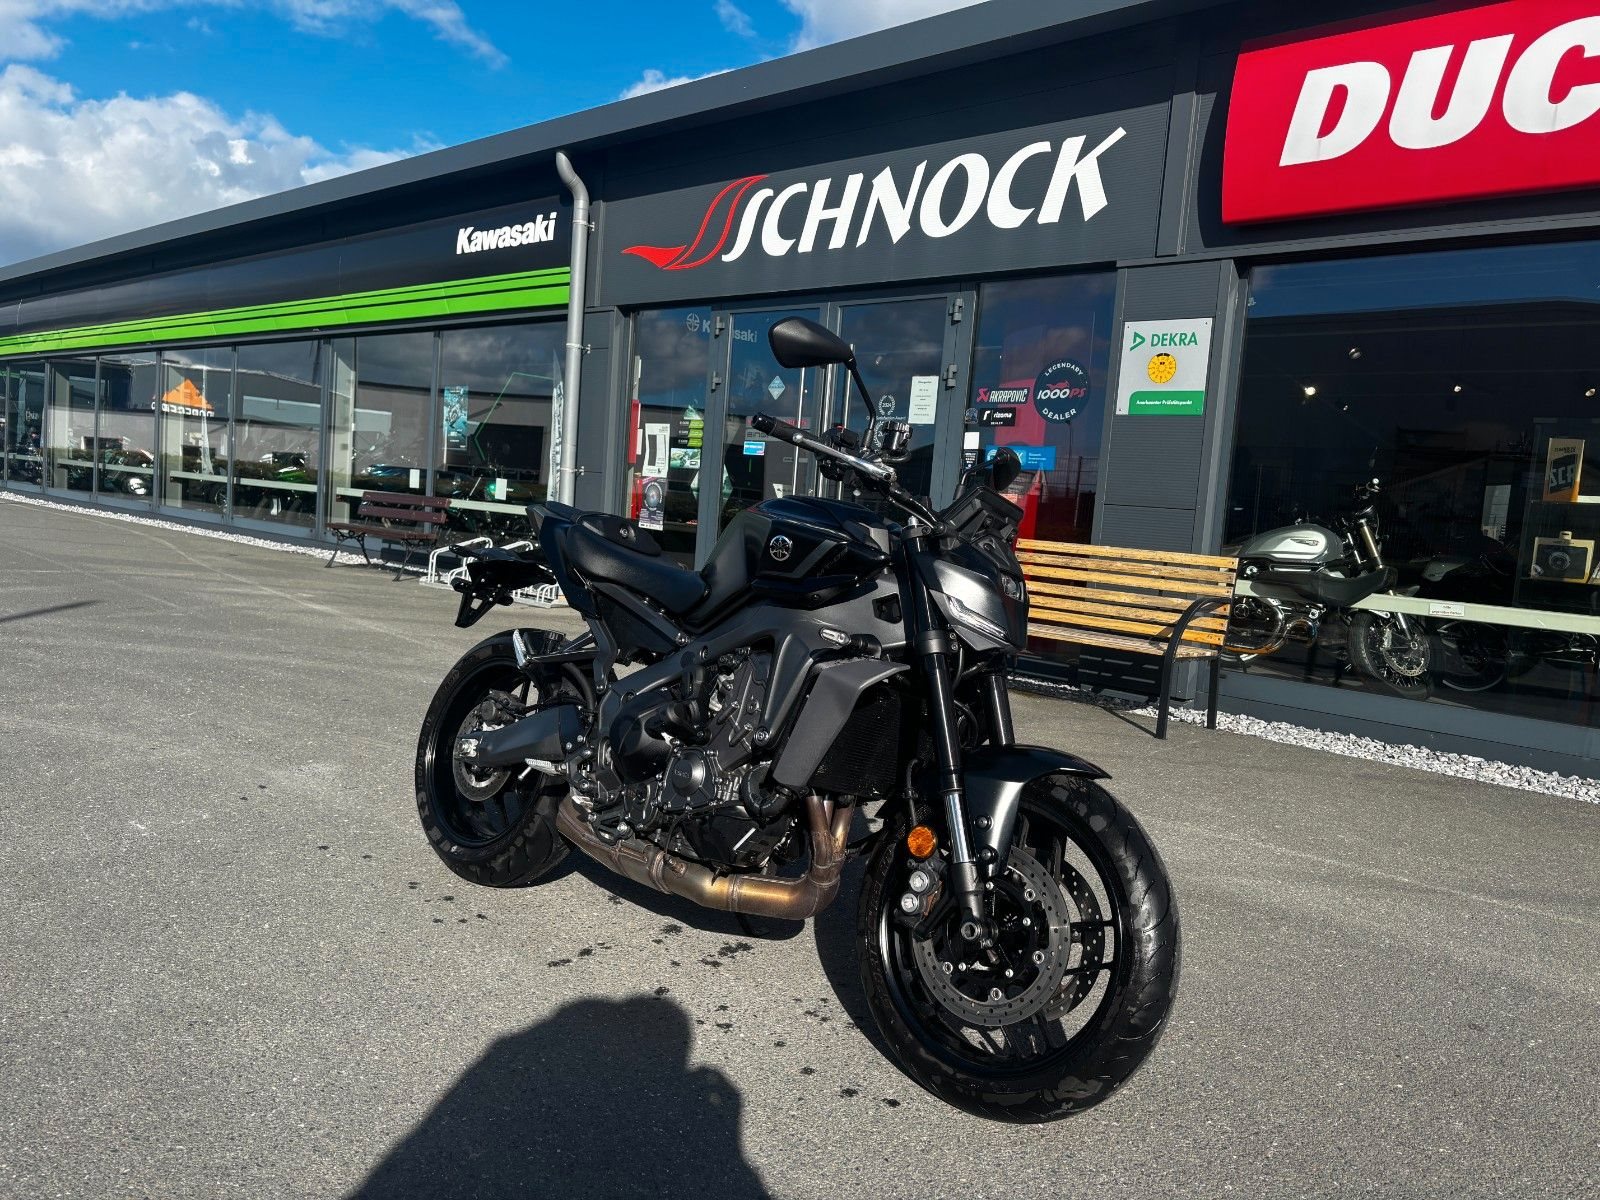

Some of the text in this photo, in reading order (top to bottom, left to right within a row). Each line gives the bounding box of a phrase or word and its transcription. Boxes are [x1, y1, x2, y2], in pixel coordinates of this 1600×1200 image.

[722, 126, 1127, 262] SCHNOCK
[456, 211, 558, 255] Kawasaki
[1150, 331, 1198, 347] DEKRA
[1044, 362, 1083, 377] LEGENDARY
[1037, 387, 1087, 400] 1000PS
[1042, 407, 1077, 421] DEALER
